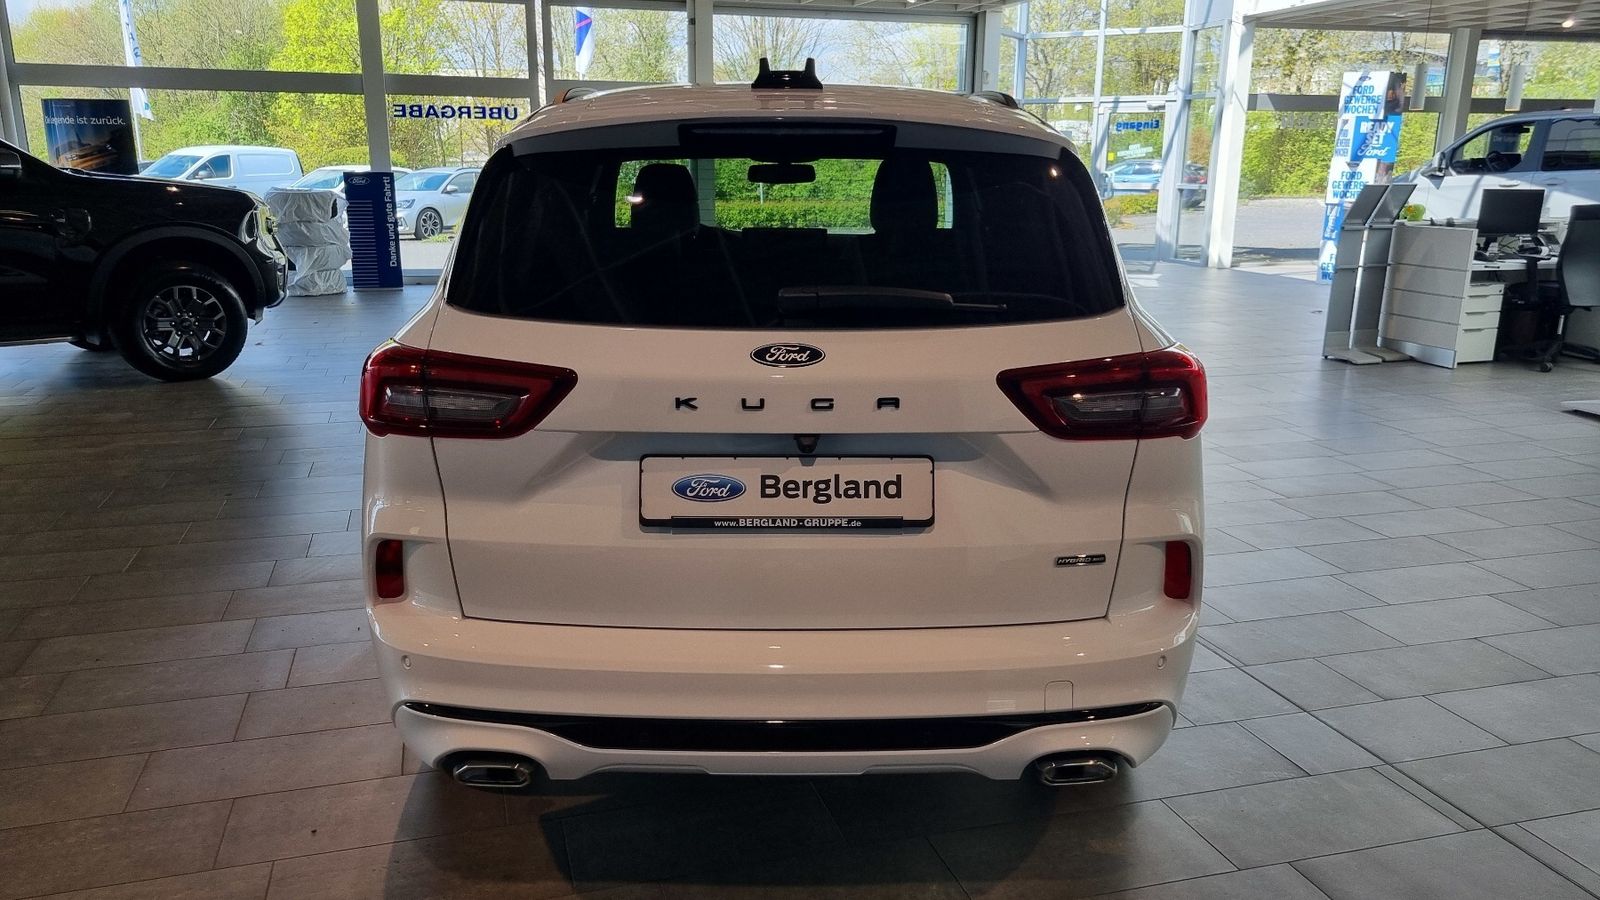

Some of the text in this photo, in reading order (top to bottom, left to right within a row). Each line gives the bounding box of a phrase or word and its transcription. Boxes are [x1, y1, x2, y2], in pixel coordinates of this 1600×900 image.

[1352, 85, 1375, 95] FORD
[1344, 95, 1382, 104] GEWERBE
[1344, 105, 1379, 114] WOCHEN
[76, 115, 88, 125] ist
[90, 115, 126, 125] zurück.
[1360, 121, 1395, 134] READY
[1365, 132, 1386, 146] SET
[1357, 144, 1391, 156] Ford
[1341, 171, 1363, 180] FORD
[1332, 181, 1369, 190] GEWERB
[383, 176, 397, 267] Danke und gute Fahrt!
[765, 346, 811, 362] Ford
[675, 397, 900, 410] KUGA
[686, 473, 902, 504] Ford Bergland
